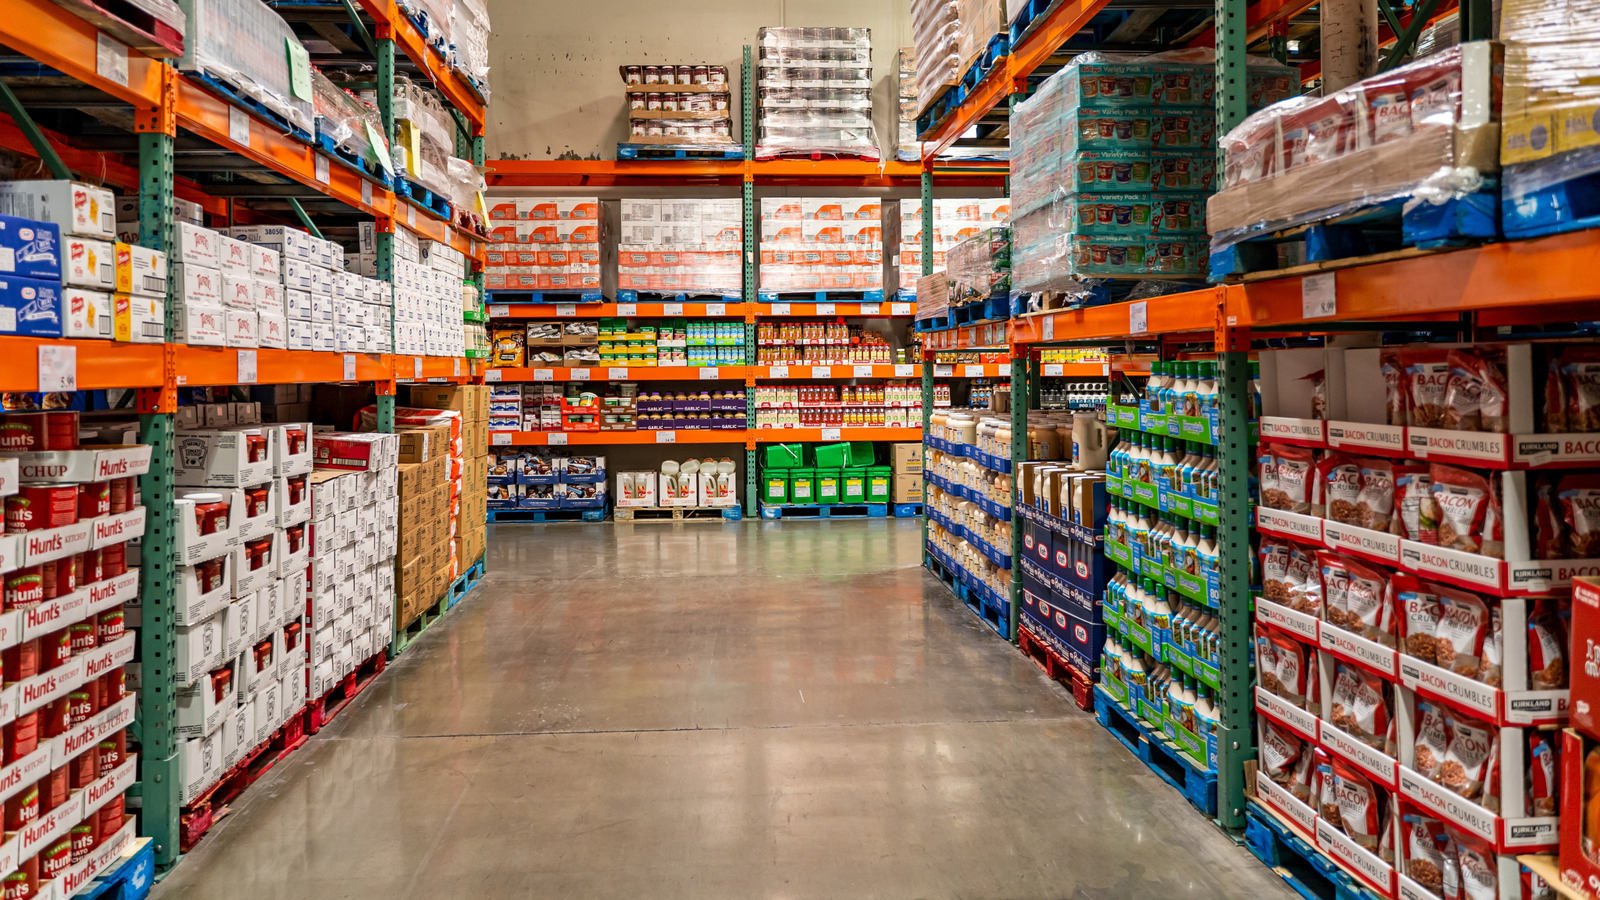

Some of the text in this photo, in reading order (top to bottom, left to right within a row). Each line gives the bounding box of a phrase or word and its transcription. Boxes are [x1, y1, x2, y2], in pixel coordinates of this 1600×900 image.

[1321, 301, 1334, 313] 8.99
[1274, 424, 1290, 433] BACON
[1290, 425, 1320, 436] CRUMBLES
[1344, 430, 1400, 444] BACON CRUMBLES
[1429, 438, 1500, 454] BACON CRUMBLES
[19, 466, 68, 478] CHUP
[100, 458, 127, 476] Hunt's
[1434, 493, 1475, 508] BACON
[97, 521, 123, 540] Hunt's
[1272, 518, 1319, 536] BACON CRUMBLES
[30, 534, 62, 556] Hunt's
[1340, 533, 1398, 556] BACON CRUMBLES
[1422, 553, 1494, 579] BACON CRUMBLES
[90, 582, 116, 604] Hunt's
[1210, 588, 1219, 600] 80
[28, 604, 60, 628] Hunt's
[1269, 610, 1314, 635] BACON CRUMBLES
[1445, 606, 1478, 627] BACON
[86, 652, 112, 677] Hunt's
[1336, 637, 1392, 669] BACON CRUMBLES
[24, 676, 56, 704] Hunt's
[1420, 672, 1492, 709] BACON CRUMBLES
[1513, 700, 1550, 708] KIRKLAND
[1269, 702, 1314, 733] BACON CRUMBLES
[64, 709, 130, 756] Hunt's KETCHUP
[1265, 735, 1291, 759] BACON
[1336, 739, 1392, 778] BACON CRUMBLES
[88, 775, 115, 804] Hunt's
[1336, 787, 1367, 808] BACON
[1269, 787, 1314, 828] BACON CRUMBLES
[1420, 788, 1492, 835] BACON CRUMBLES
[24, 816, 56, 848] Hunt's
[1512, 826, 1550, 834] KIRKLAND
[1332, 839, 1388, 884] BACON CRUMBLES
[64, 857, 96, 894] Hunt's
